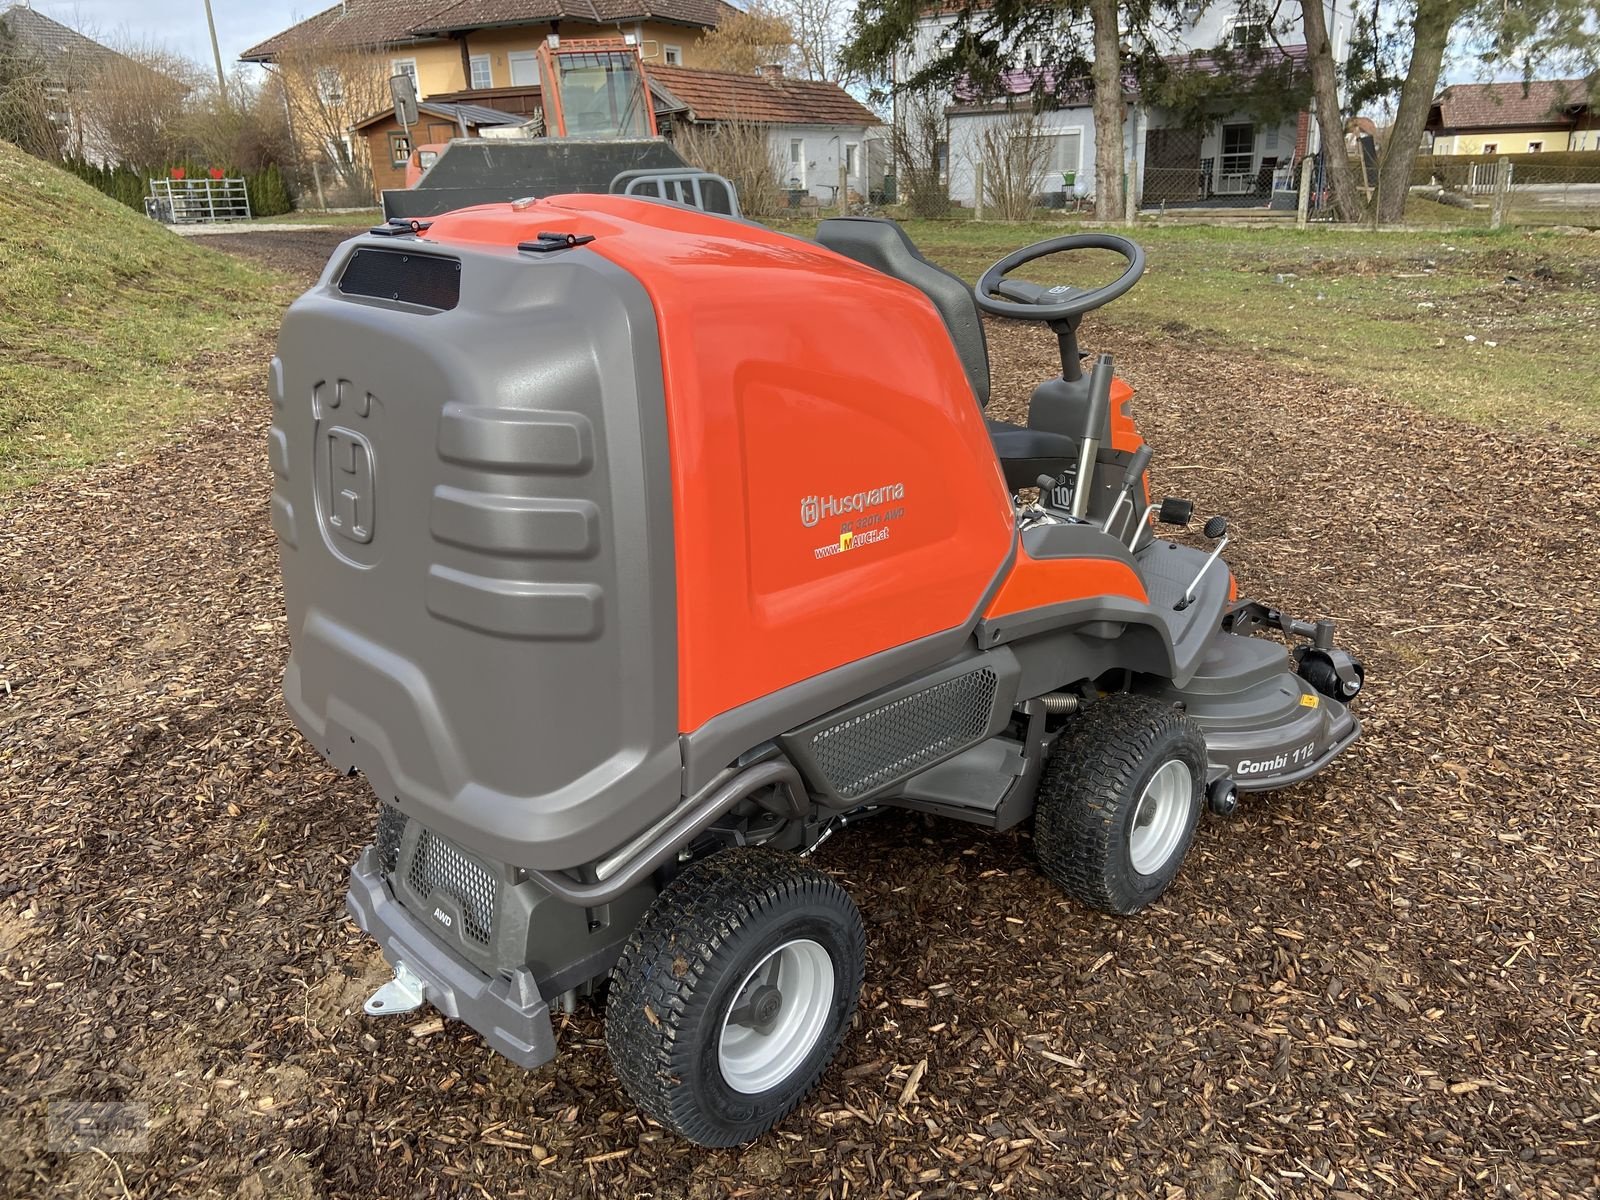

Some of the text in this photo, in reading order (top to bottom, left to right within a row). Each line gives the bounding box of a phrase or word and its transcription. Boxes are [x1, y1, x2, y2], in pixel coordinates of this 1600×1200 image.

[821, 482, 905, 519] Husqvarna
[884, 507, 905, 523] AWD
[1237, 742, 1315, 774] Combi 112
[433, 907, 452, 927] AWD
